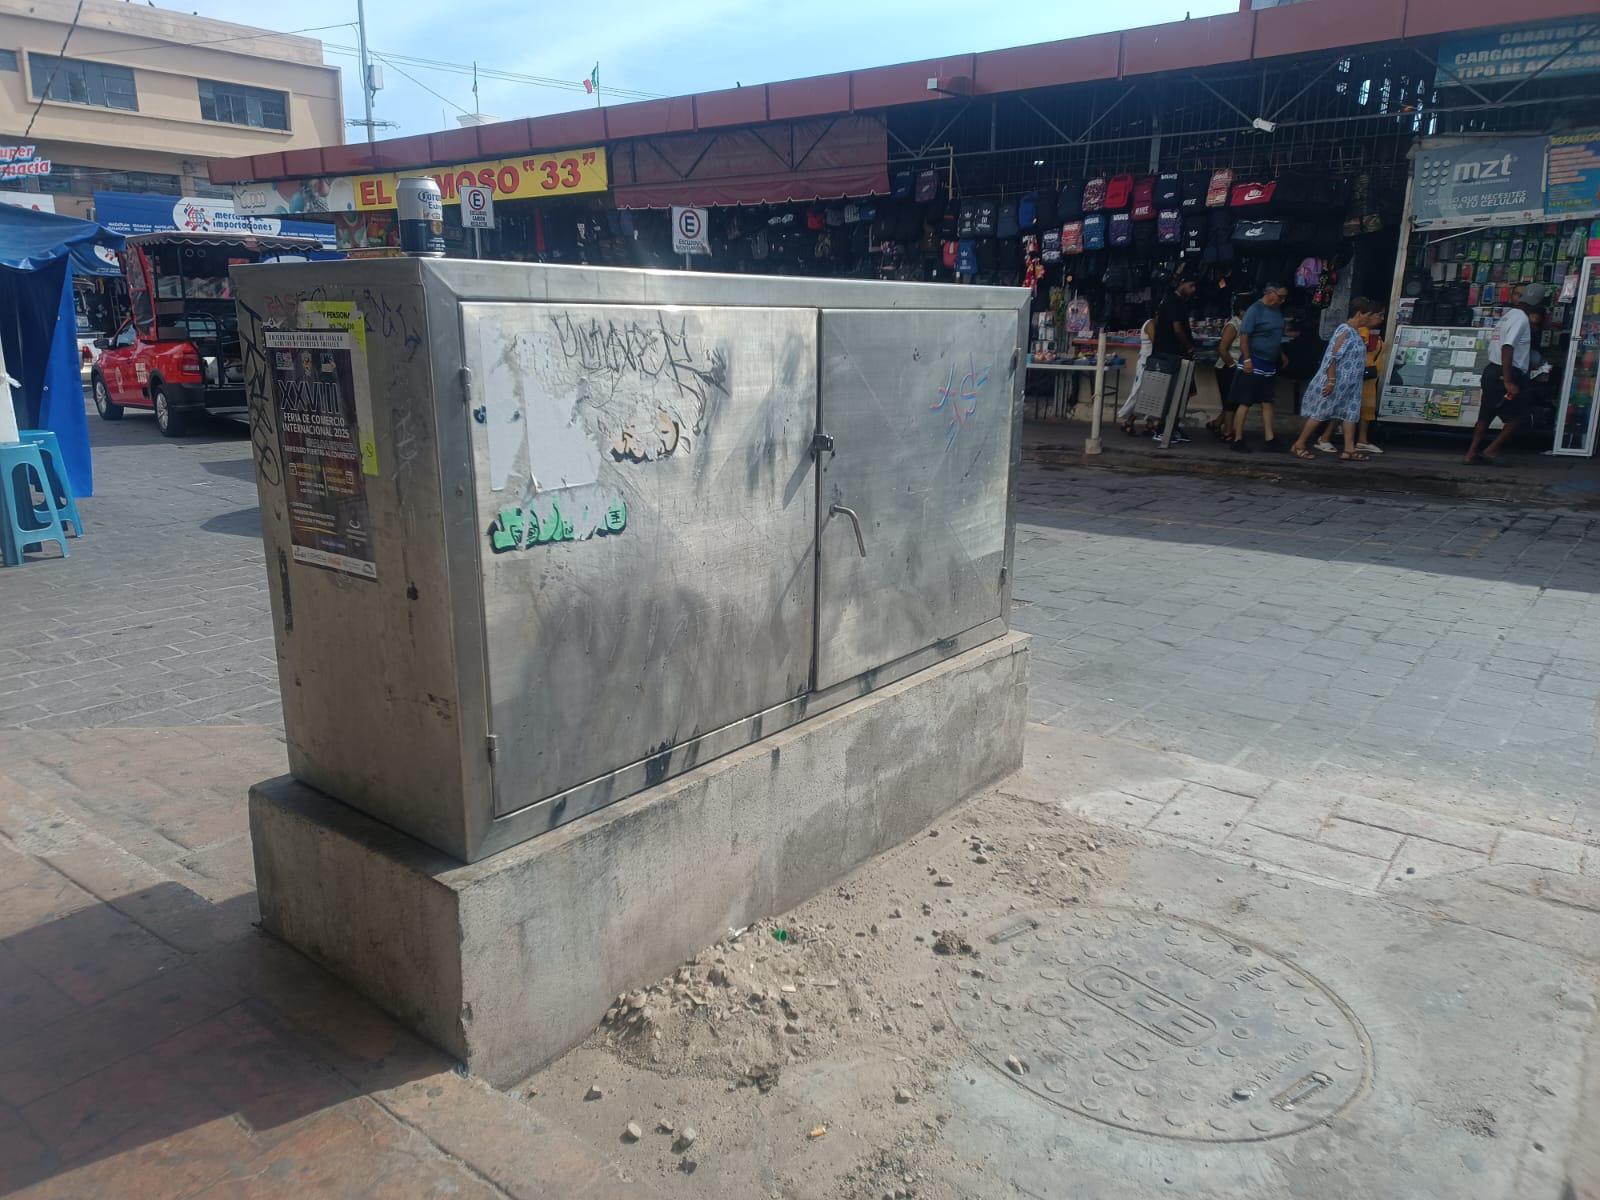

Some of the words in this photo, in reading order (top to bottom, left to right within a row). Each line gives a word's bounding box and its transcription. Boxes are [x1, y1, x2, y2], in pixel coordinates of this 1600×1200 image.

[1457, 65, 1496, 79] TIPO
[1500, 62, 1521, 75] DE
[0, 147, 33, 159] uper
[1454, 153, 1512, 181] mzt
[359, 179, 392, 206] EL
[473, 193, 481, 207] E
[1481, 190, 1527, 200] NECESITES
[1481, 196, 1526, 207] CELULAR
[685, 215, 695, 232] E
[278, 380, 341, 414] XXVIII
[283, 412, 302, 423] FERIA
[302, 413, 310, 423] DE
[311, 415, 345, 427] COMERCIO
[282, 422, 333, 437] INTERNACIONAL
